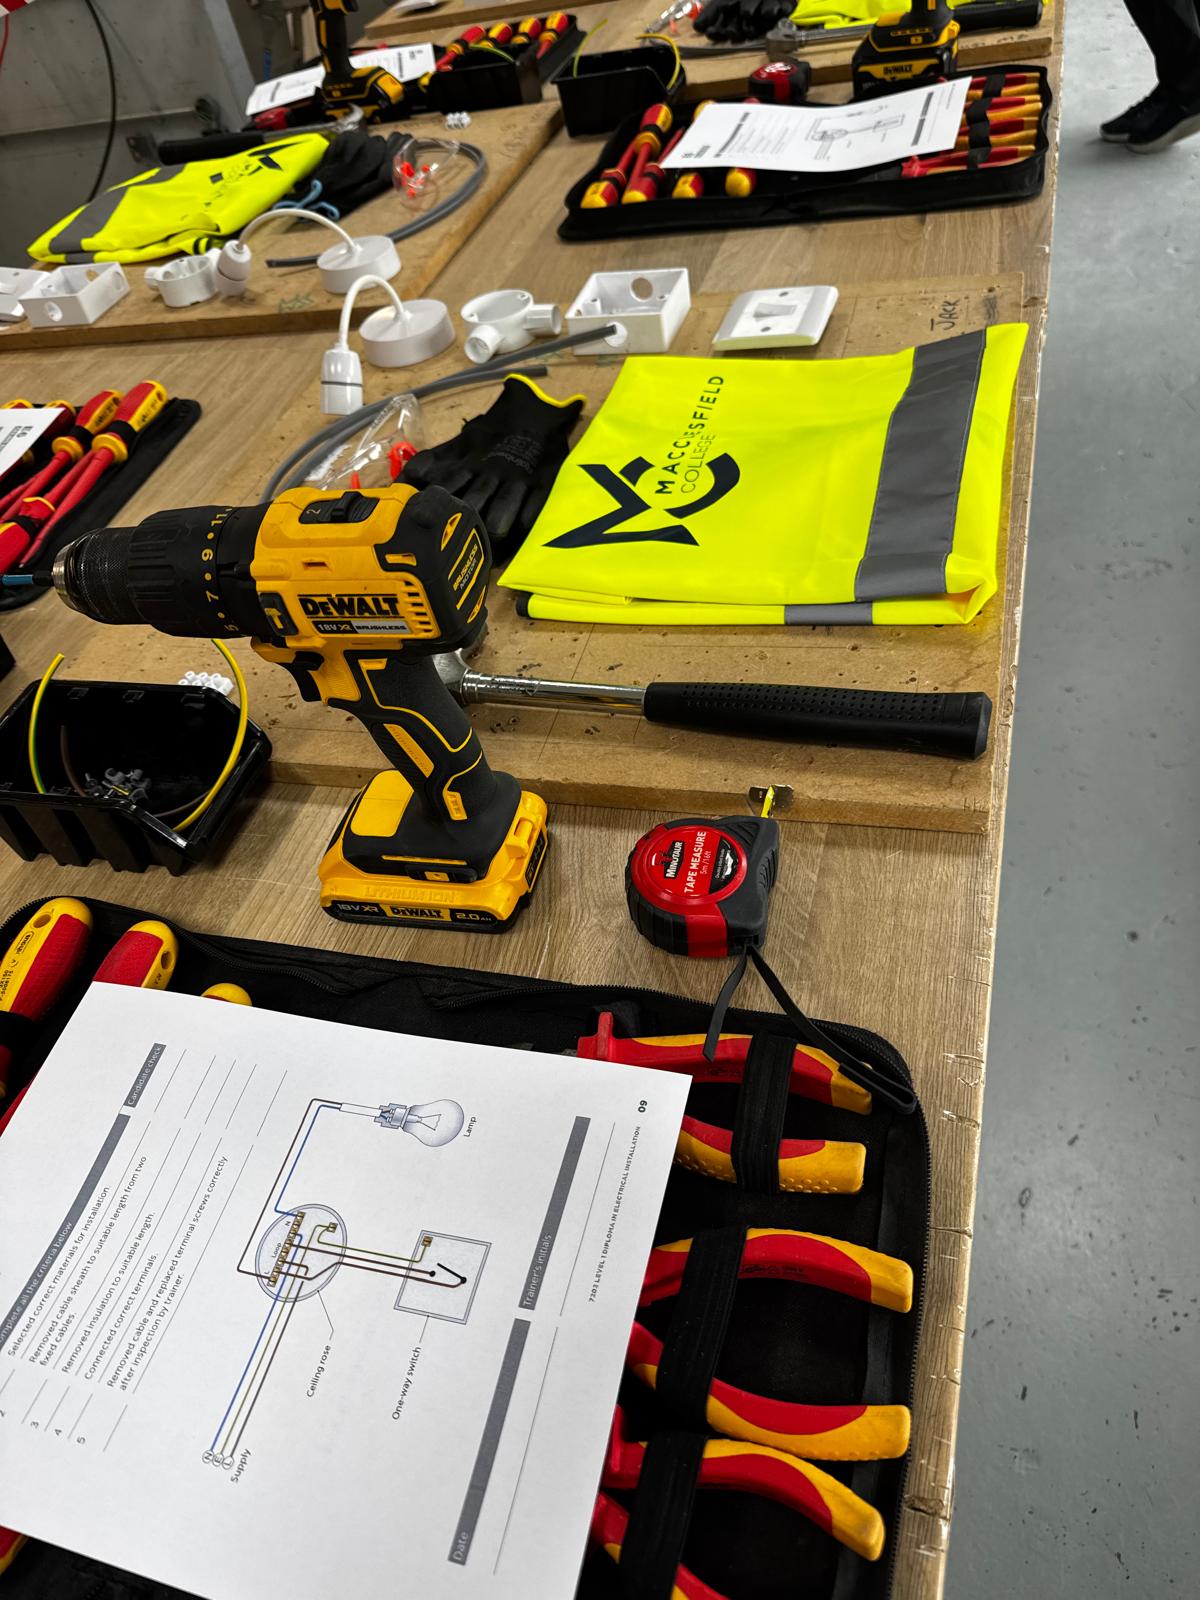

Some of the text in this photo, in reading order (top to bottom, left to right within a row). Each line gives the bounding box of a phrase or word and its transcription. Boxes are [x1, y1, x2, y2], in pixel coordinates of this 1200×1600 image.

[205, 590, 219, 602] 7
[299, 596, 401, 618] DEWALT
[316, 622, 338, 632] 18V
[665, 841, 683, 878] MINOTAUR
[684, 831, 707, 894] TAPE MEASURE
[336, 903, 360, 912] 18V
[128, 1046, 162, 1105] Candidate check
[637, 1100, 648, 1113] 09
[463, 1116, 477, 1138] Lamp
[620, 1126, 641, 1172] INSTALLATION
[614, 1172, 630, 1214] ELECTRICAL
[611, 1213, 618, 1224] IN
[271, 1242, 282, 1259] Loop
[603, 1223, 616, 1255] DIPLOMA
[7, 1185, 111, 1356] Selected correct materials for installation.
[20, 1295, 30, 1306] all
[26, 1278, 39, 1294] the
[37, 1246, 57, 1277] criteria
[54, 1221, 73, 1247] below
[29, 1156, 147, 1363] Removed cable sheath to suitable length from two
[106, 1156, 229, 1388] Removed cable and replaced terminal screws correctly
[522, 1233, 552, 1307] Trainer's initials
[594, 1259, 606, 1285] LEVEL
[61, 1212, 156, 1373] Removed insulation to suitable length.
[84, 1252, 158, 1380] Connected correct terminals.
[119, 1274, 185, 1391] after inspection by trainer.
[39, 1312, 77, 1367] fixed cables.
[306, 1344, 331, 1398] Ceiling rose
[392, 1346, 422, 1420] One-way switch
[30, 1421, 40, 1430] 3
[54, 1428, 63, 1437] 4
[76, 1436, 86, 1445] 5
[230, 1448, 252, 1484] Supply
[452, 1531, 470, 1562] Date
